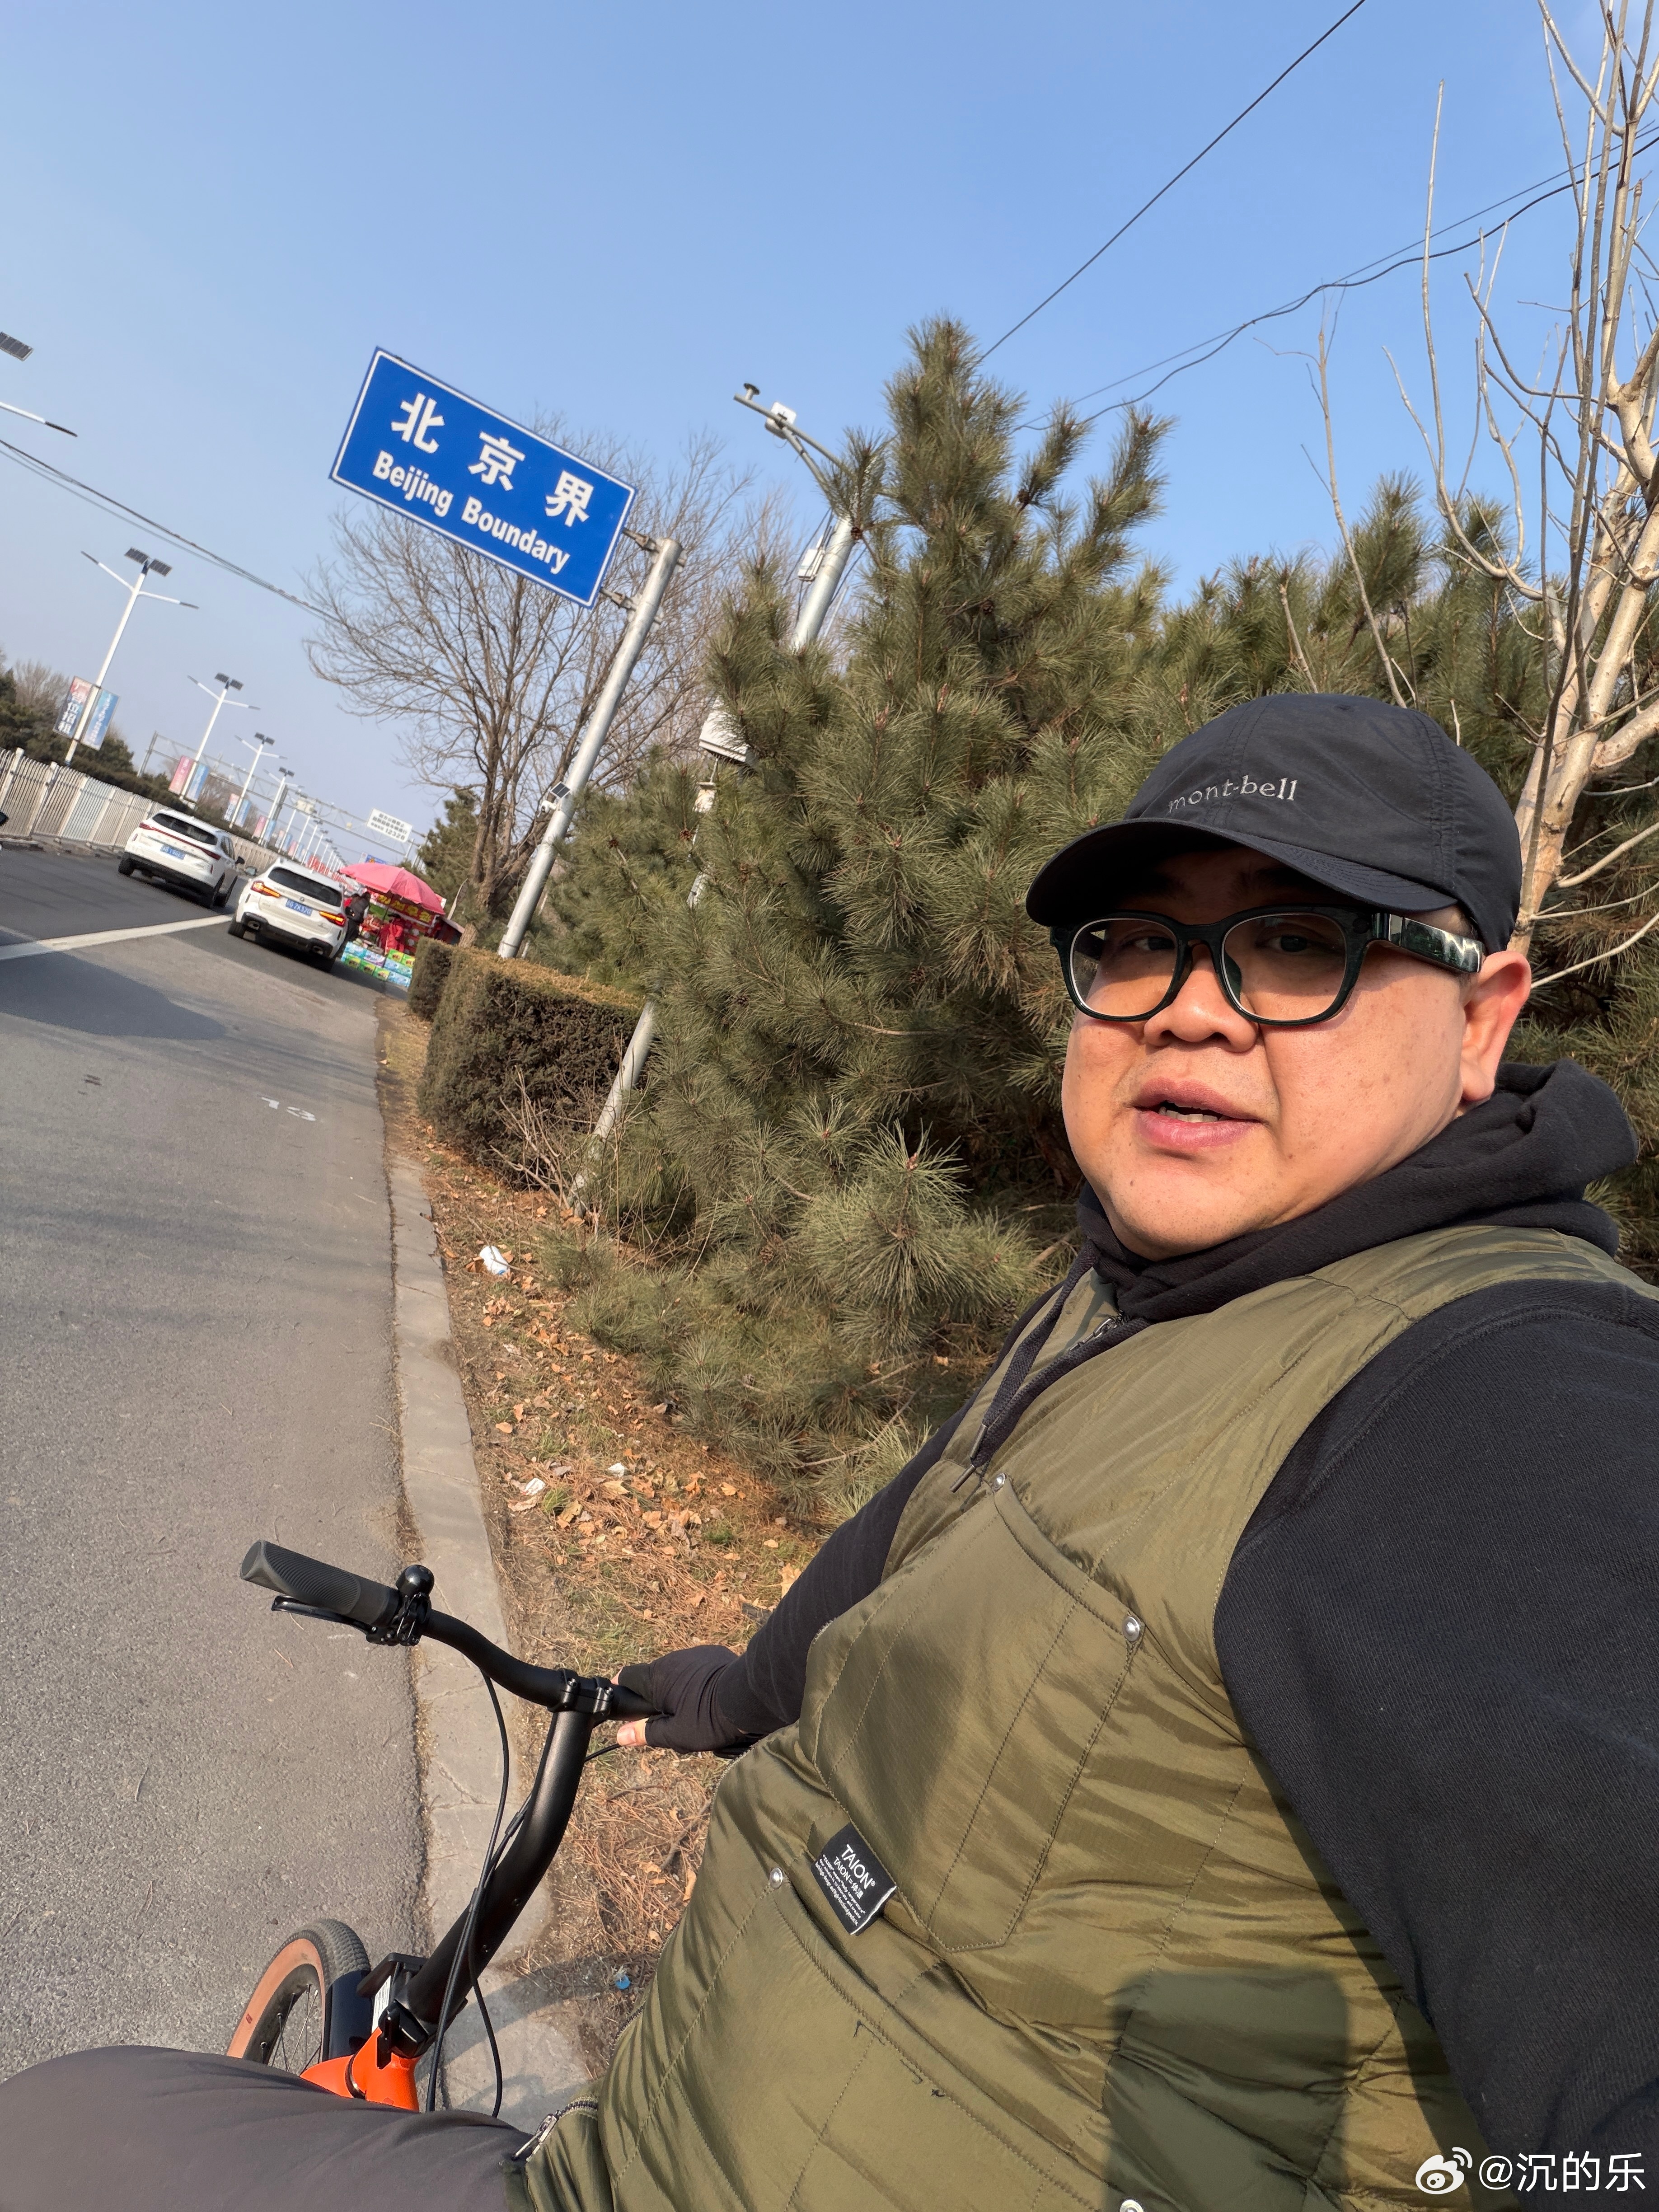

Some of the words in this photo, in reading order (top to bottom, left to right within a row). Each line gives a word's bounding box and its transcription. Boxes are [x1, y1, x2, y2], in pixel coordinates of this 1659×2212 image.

[372, 450, 454, 518] Beijing
[461, 496, 571, 575] Boundary
[391, 392, 594, 527] 北京界
